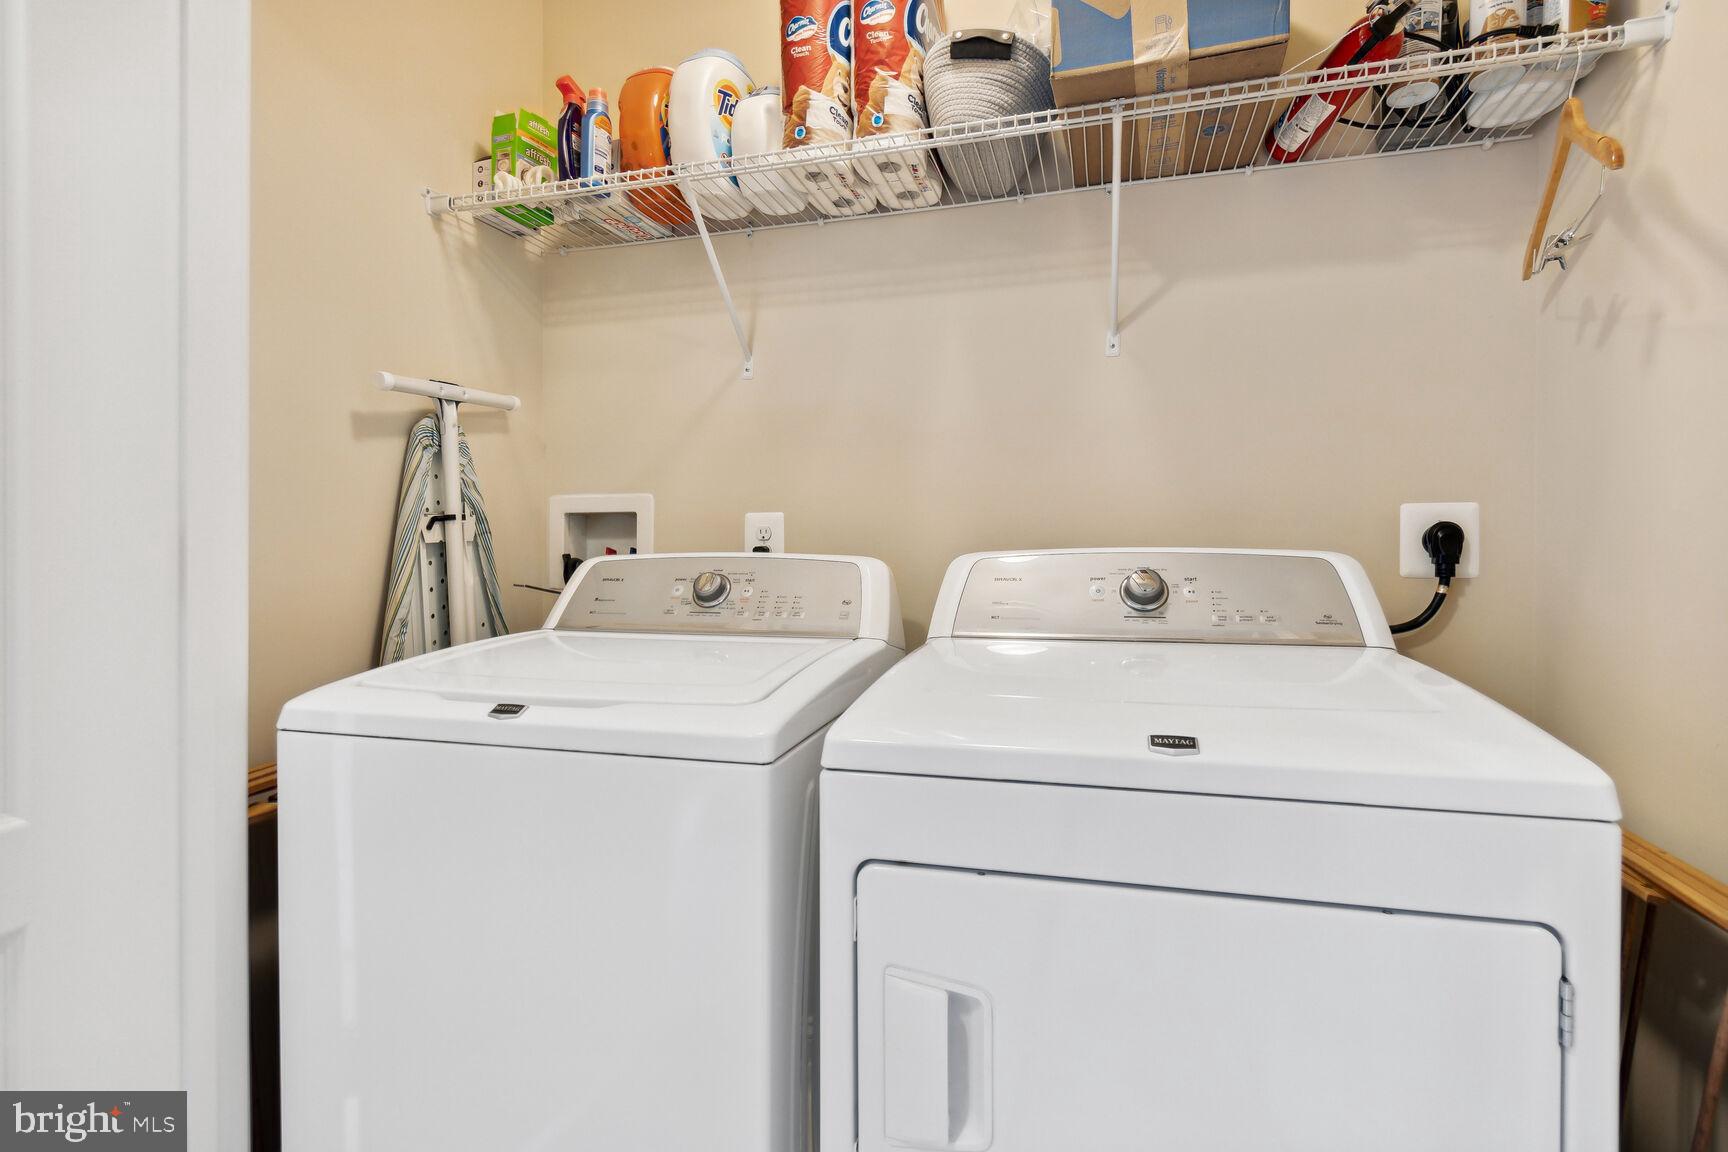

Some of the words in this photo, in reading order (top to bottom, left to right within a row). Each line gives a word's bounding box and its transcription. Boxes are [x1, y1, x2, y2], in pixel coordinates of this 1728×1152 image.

[790, 44, 811, 54] Clean
[793, 51, 810, 59] Touch
[717, 88, 739, 117] Tid
[829, 106, 849, 127] Clean
[528, 119, 550, 138] affresh
[525, 148, 552, 168] affresh
[1153, 737, 1194, 745] MAYTAG
